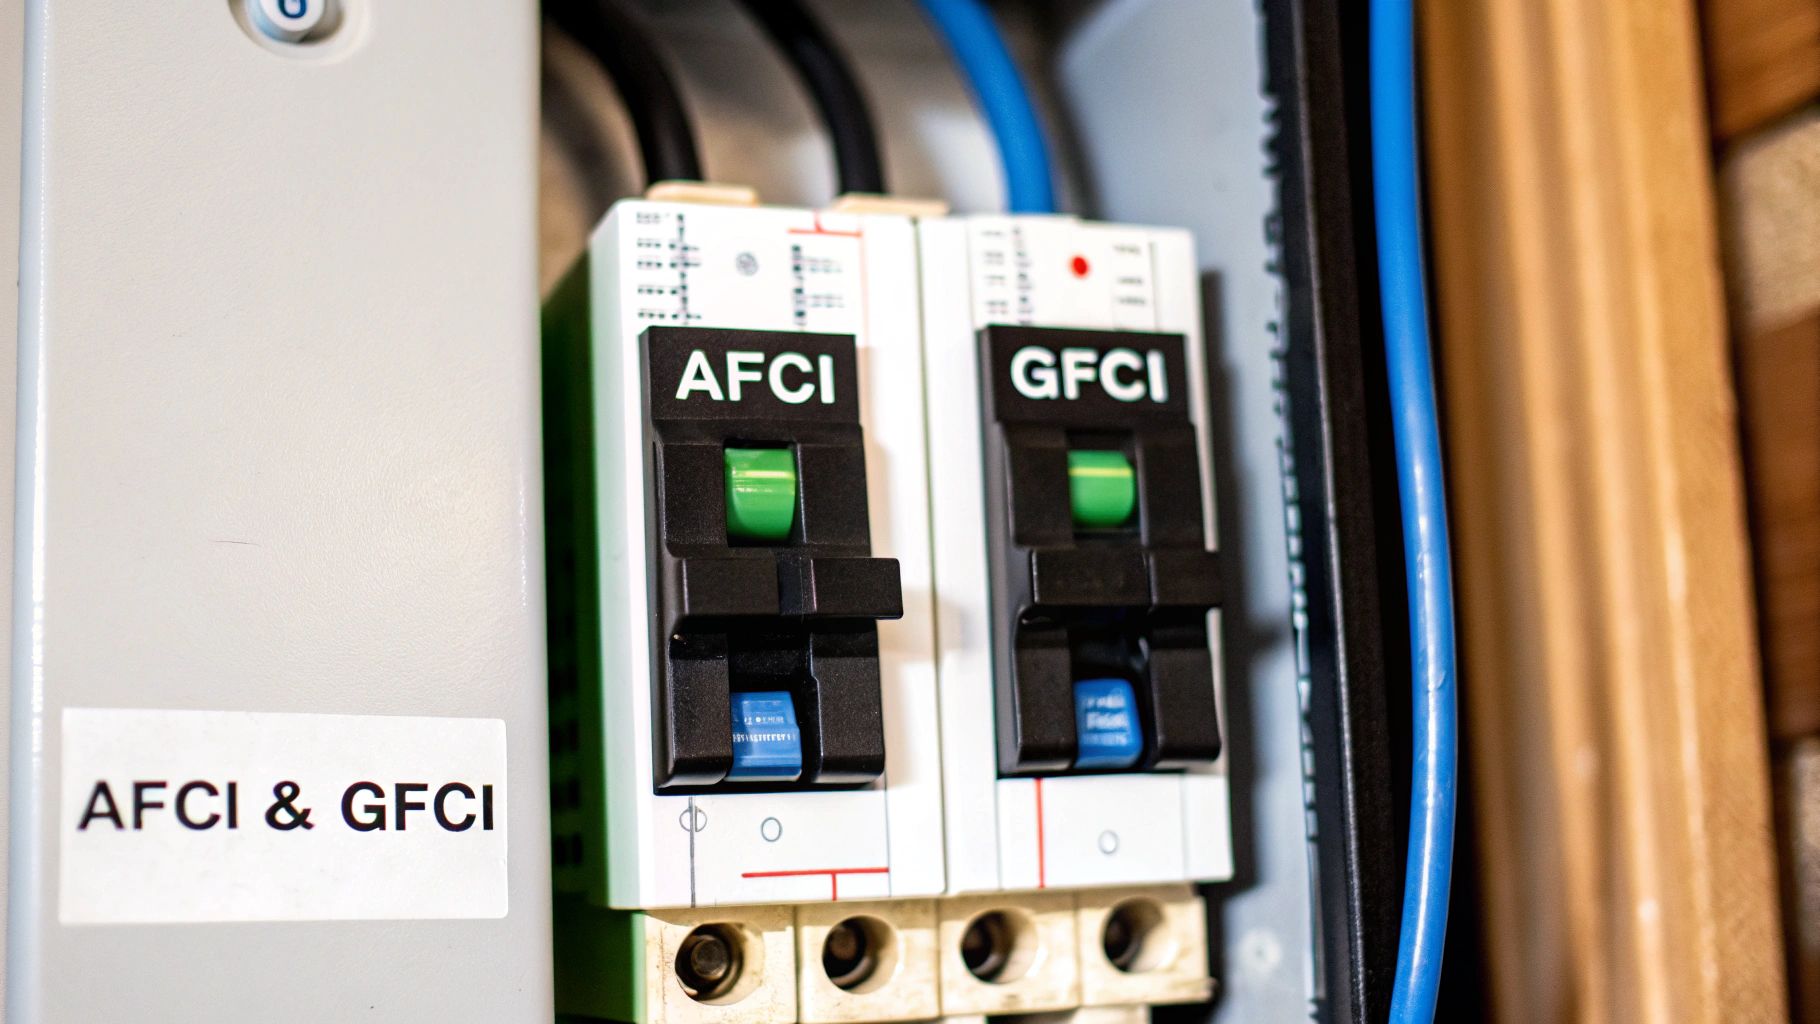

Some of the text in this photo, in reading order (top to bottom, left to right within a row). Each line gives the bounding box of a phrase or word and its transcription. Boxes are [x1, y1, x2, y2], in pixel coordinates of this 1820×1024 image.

[676, 350, 835, 404] AFCI
[1010, 347, 1167, 403] GFCI
[79, 781, 494, 832] AFCI & GFCI
